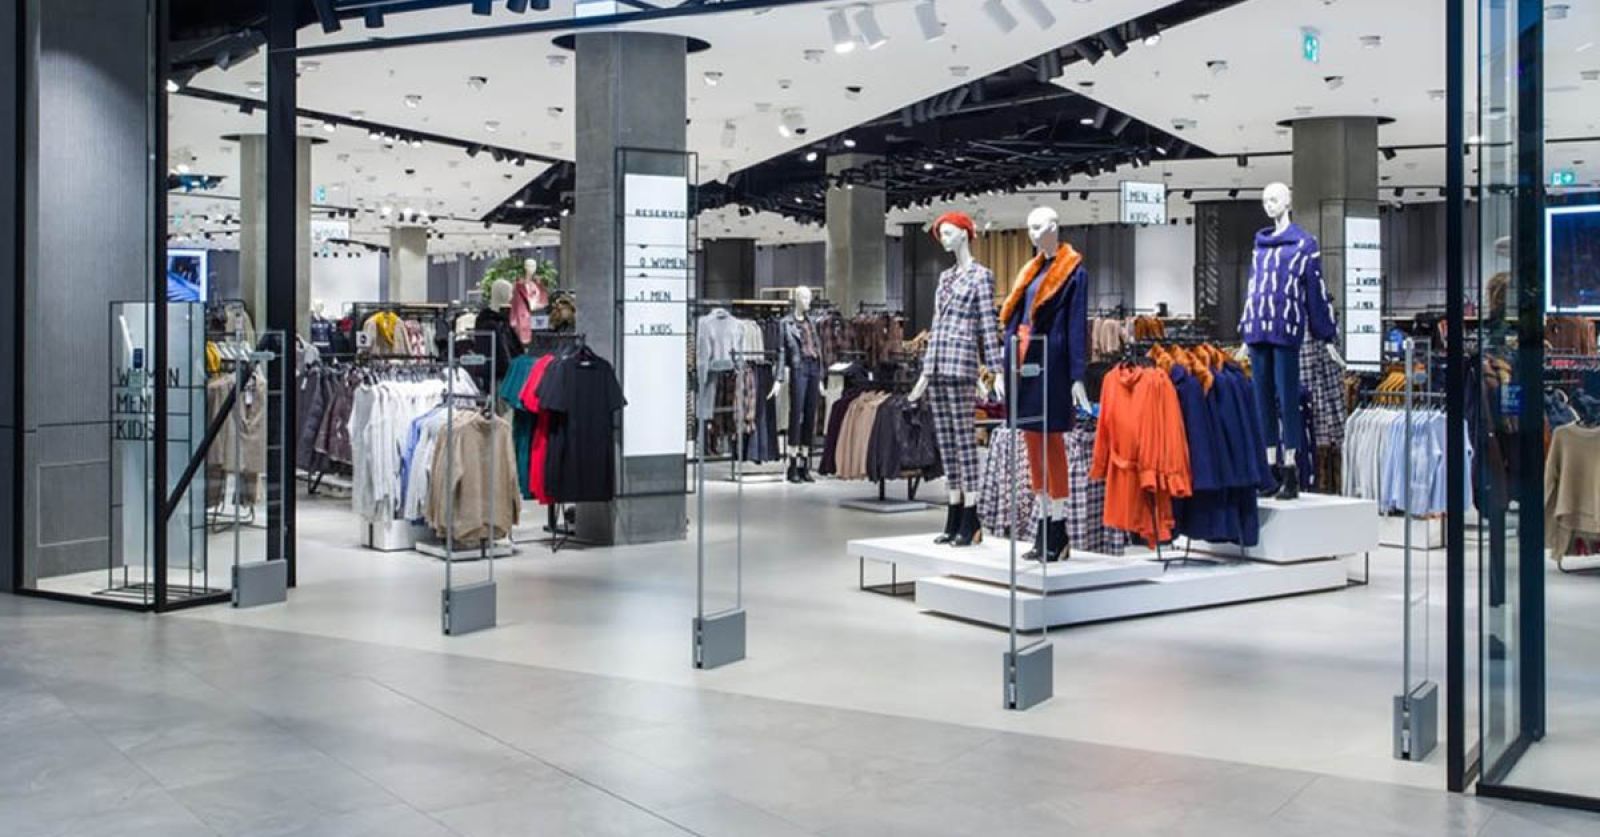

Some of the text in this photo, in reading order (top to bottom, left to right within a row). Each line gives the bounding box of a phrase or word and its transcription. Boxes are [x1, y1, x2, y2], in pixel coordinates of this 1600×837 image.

[1130, 191, 1148, 203] MEN
[650, 257, 688, 270] WOMEN
[650, 291, 672, 303] MEN
[650, 323, 673, 336] KIDS
[115, 367, 180, 388] WMN
[115, 393, 153, 413] MEN
[115, 419, 156, 440] KIDS
